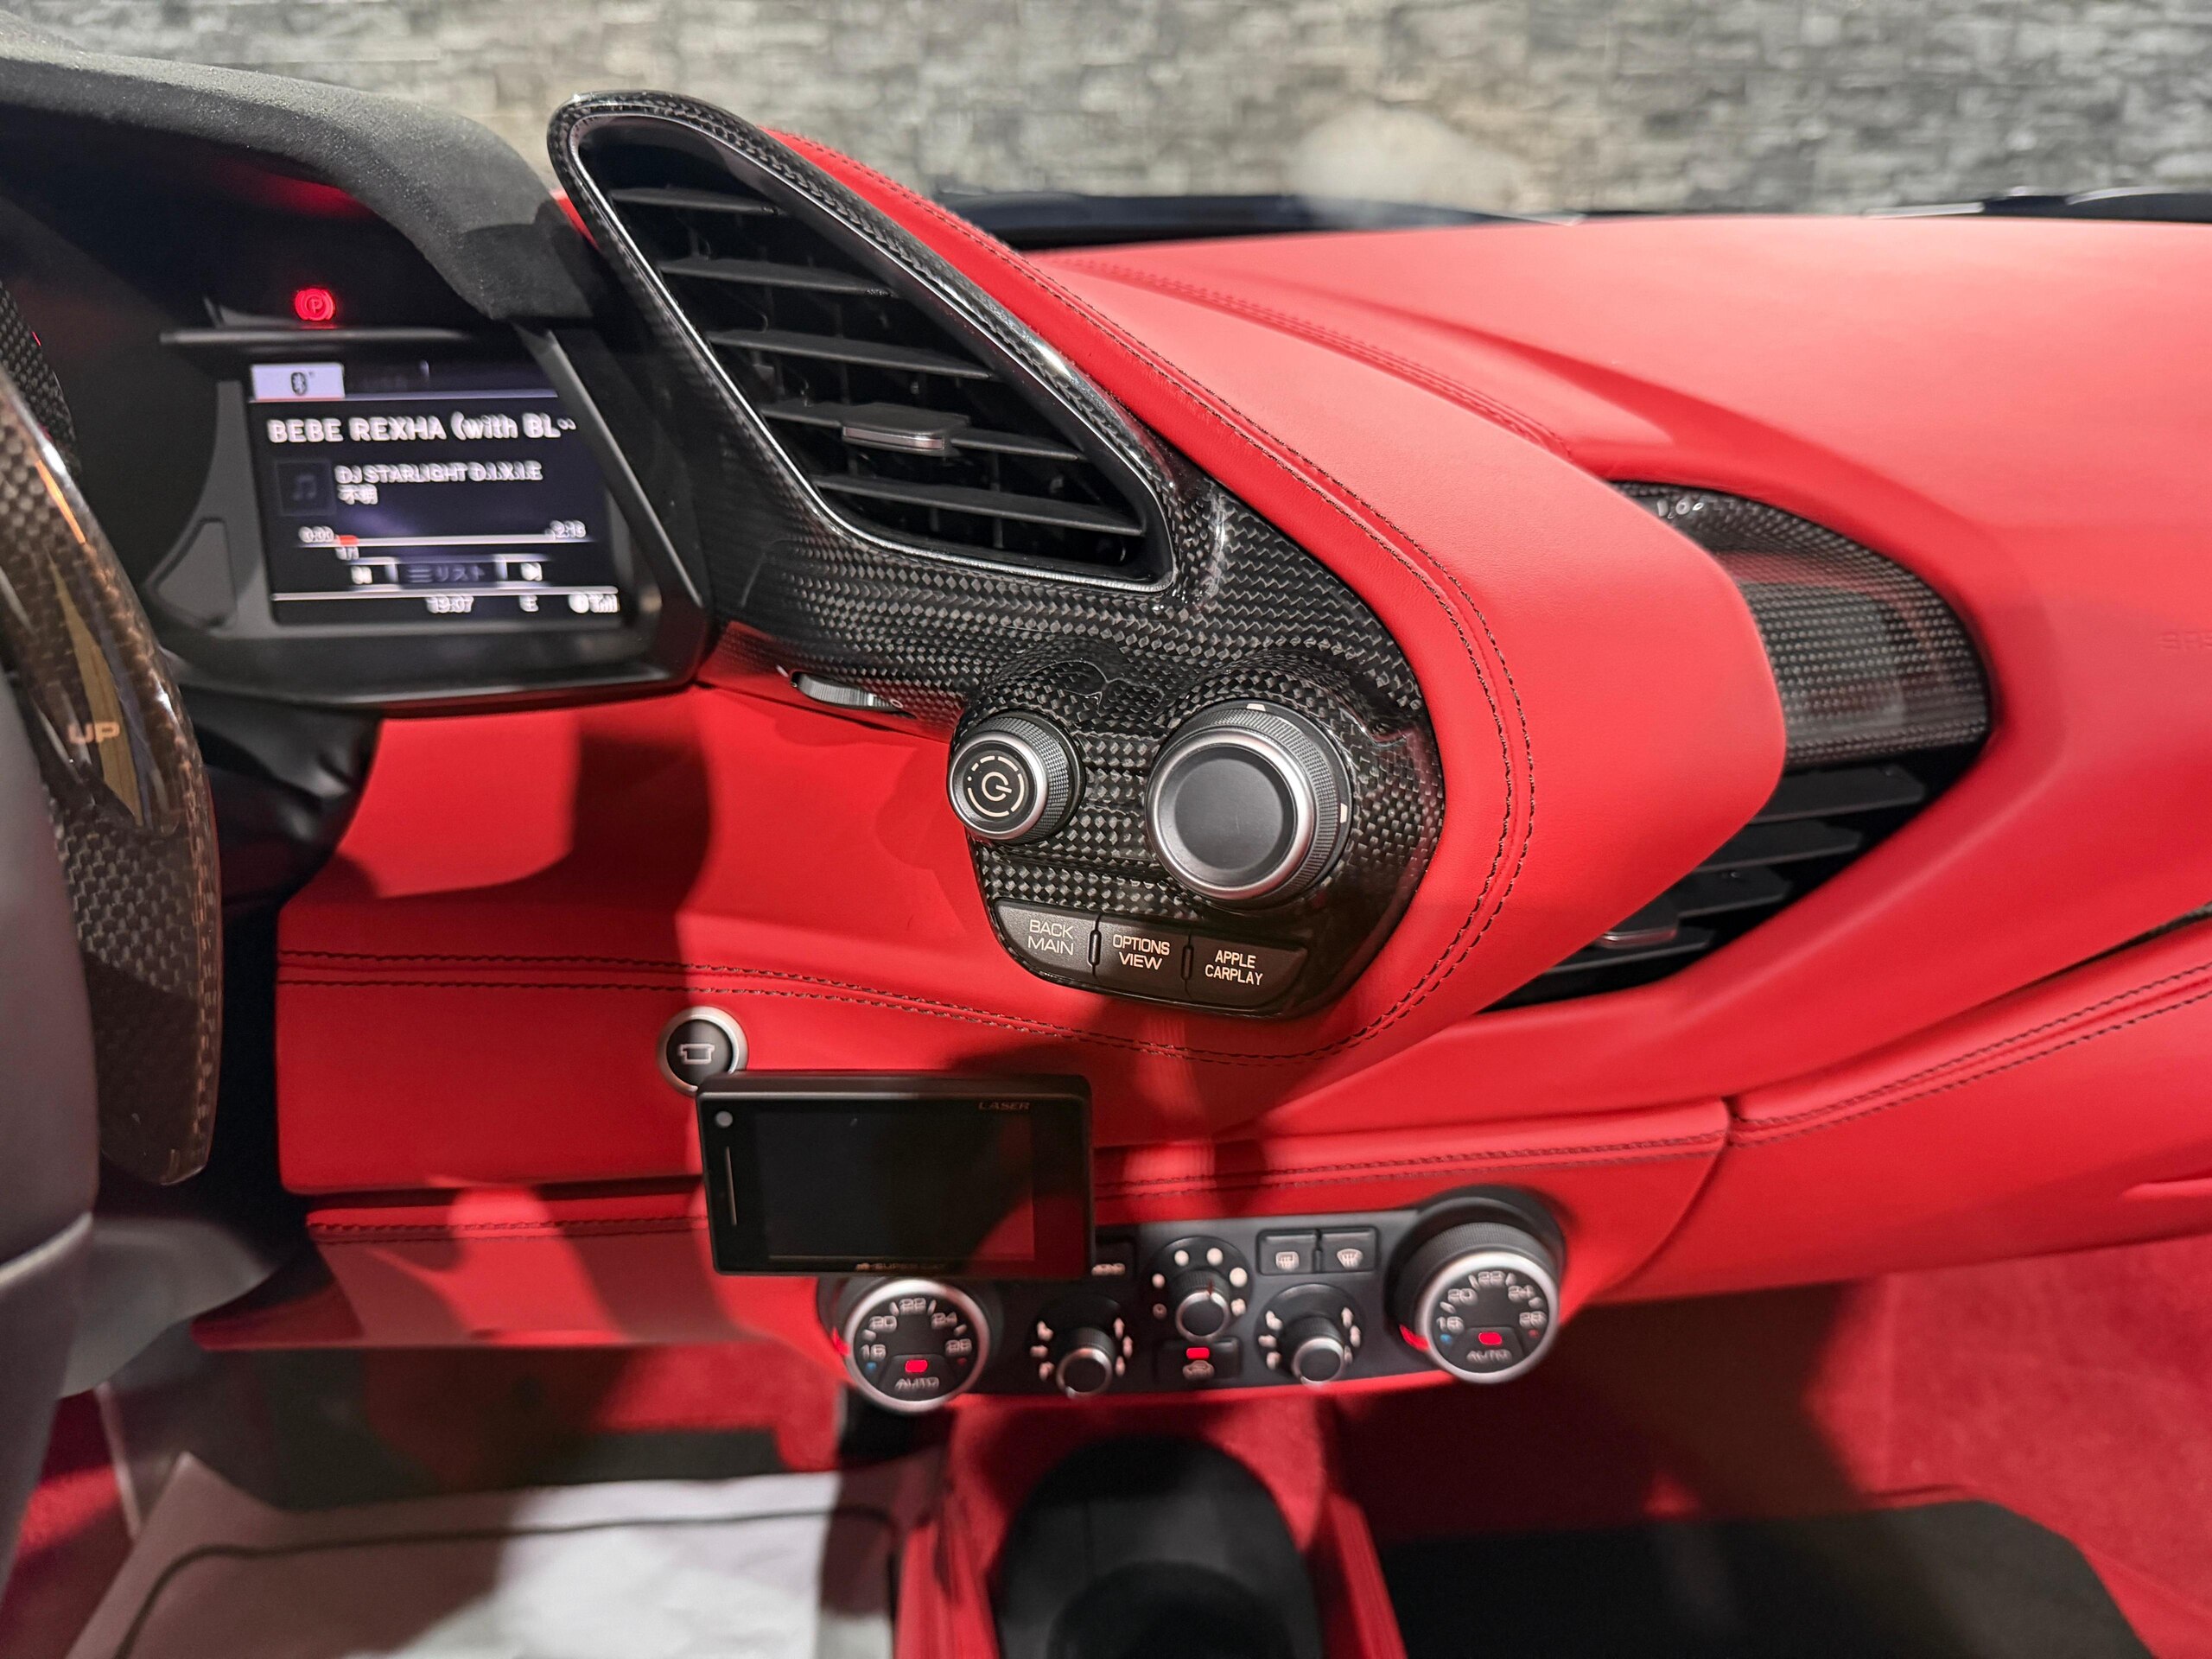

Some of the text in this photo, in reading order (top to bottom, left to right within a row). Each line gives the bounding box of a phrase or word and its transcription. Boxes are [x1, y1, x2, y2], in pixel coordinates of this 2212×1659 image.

[267, 418, 344, 443] BEBE
[348, 415, 448, 442] REXHA
[451, 410, 519, 441] (with
[334, 464, 363, 484] DJ
[363, 461, 467, 484] STARLIGHT
[67, 721, 120, 744] UP
[1028, 919, 1074, 940] BACK
[1027, 935, 1074, 956] MAIN
[1111, 934, 1171, 956] OPTIONS
[1118, 950, 1163, 971] VIEW
[1214, 950, 1256, 969] APPLE
[1204, 964, 1264, 987] CARPLAY
[978, 1102, 1031, 1111] LASER
[1478, 1271, 1506, 1288] 22
[1447, 1288, 1478, 1306] 20
[1508, 1285, 1535, 1303] 24
[899, 1297, 927, 1315] 22
[868, 1315, 898, 1333] 20
[1466, 1349, 1512, 1363] AUTO
[894, 1376, 940, 1391] AUTO
